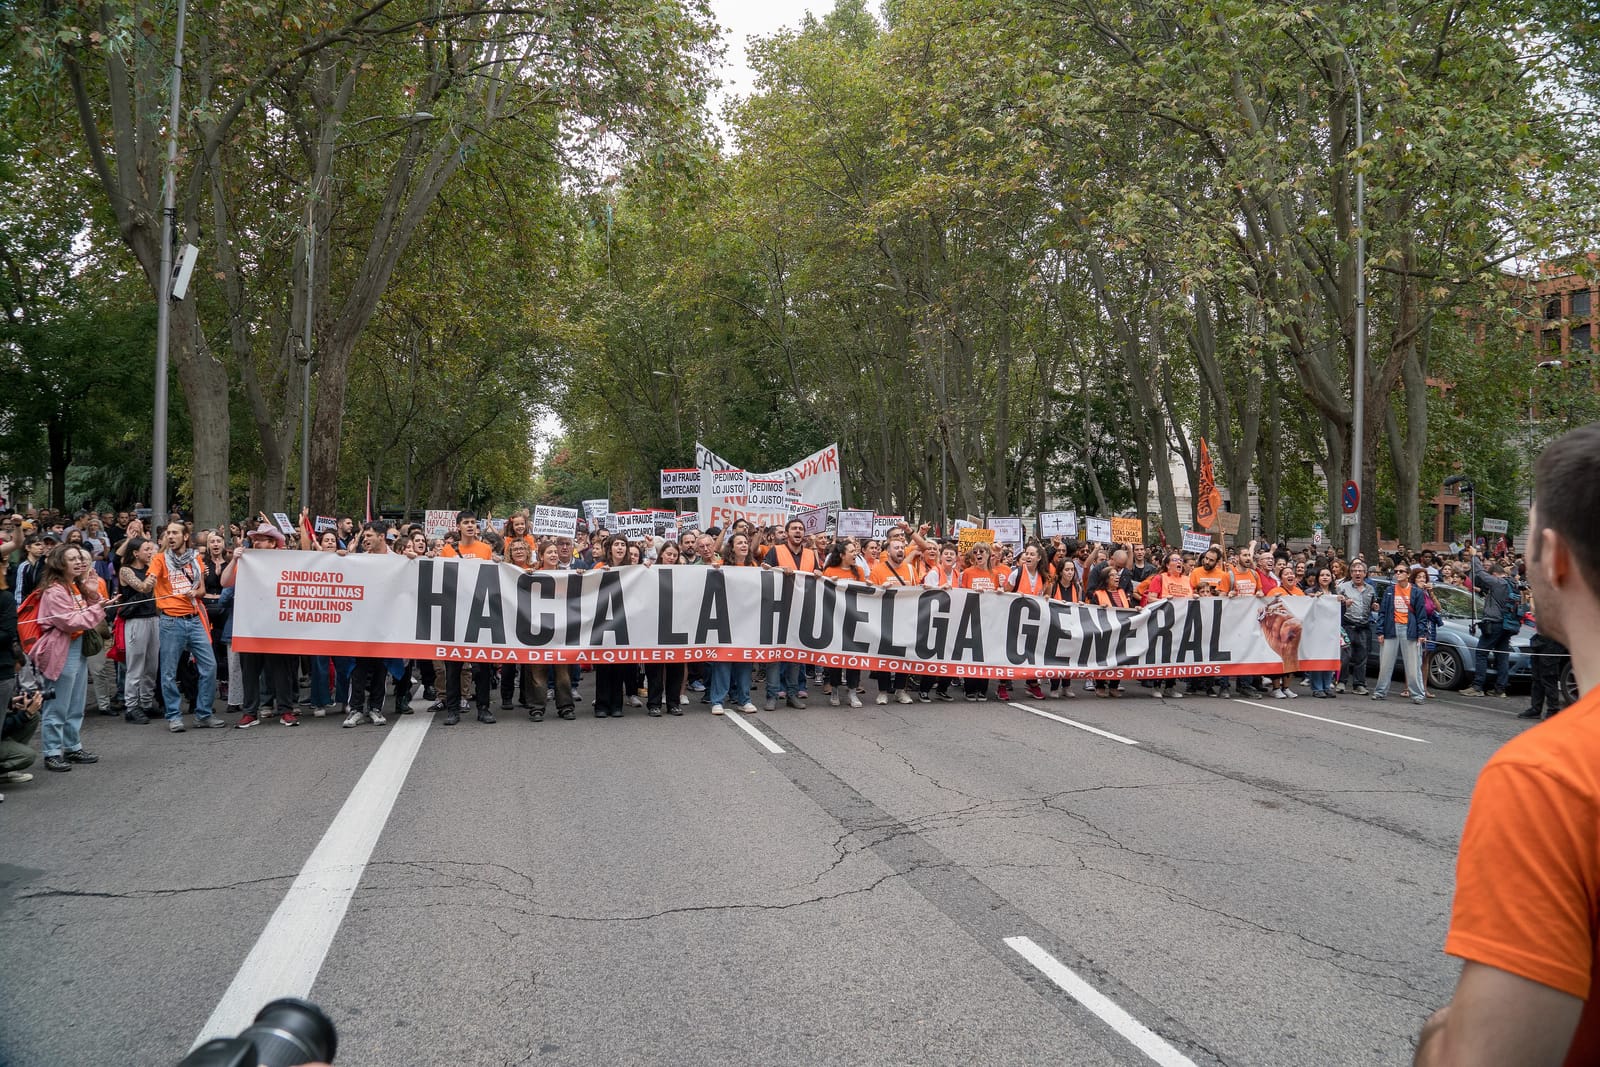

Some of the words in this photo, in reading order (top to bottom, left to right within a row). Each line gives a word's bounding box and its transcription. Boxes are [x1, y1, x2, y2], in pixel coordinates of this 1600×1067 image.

[794, 448, 837, 480] VIVIR
[663, 474, 671, 482] NO
[679, 473, 700, 482] FRAUDE
[713, 472, 743, 484] ¡PEDIMOS
[712, 486, 720, 494] LO
[722, 485, 745, 495] JUSTO!
[750, 482, 783, 493] ¡PEDIMOS
[748, 494, 758, 504] LO
[760, 495, 784, 505] JUSTO!
[618, 516, 626, 525] NO
[632, 515, 653, 524] FRAUDE
[281, 570, 344, 583] SINDICATO
[280, 586, 295, 596] DE
[297, 586, 362, 599] INQUILINAS
[279, 599, 286, 609] E
[289, 600, 353, 611] INQUILINOS
[279, 612, 293, 622] DE
[296, 613, 342, 624] MADRID
[415, 559, 629, 646] HACIA
[658, 568, 732, 645] LA
[760, 570, 984, 662] HUELGA
[1006, 596, 1231, 667] GENERAL
[435, 646, 518, 661] BAJADA
[528, 650, 566, 662] DEL
[576, 649, 676, 663] ALQUILER
[684, 648, 718, 660] 50%
[743, 649, 870, 668] EXPROPIACIÓN
[878, 659, 948, 675] FONDOS
[955, 666, 1015, 678] BUITRE
[1034, 669, 1124, 679] CONTRATOS
[1130, 665, 1221, 678] INDEFINIDOS
